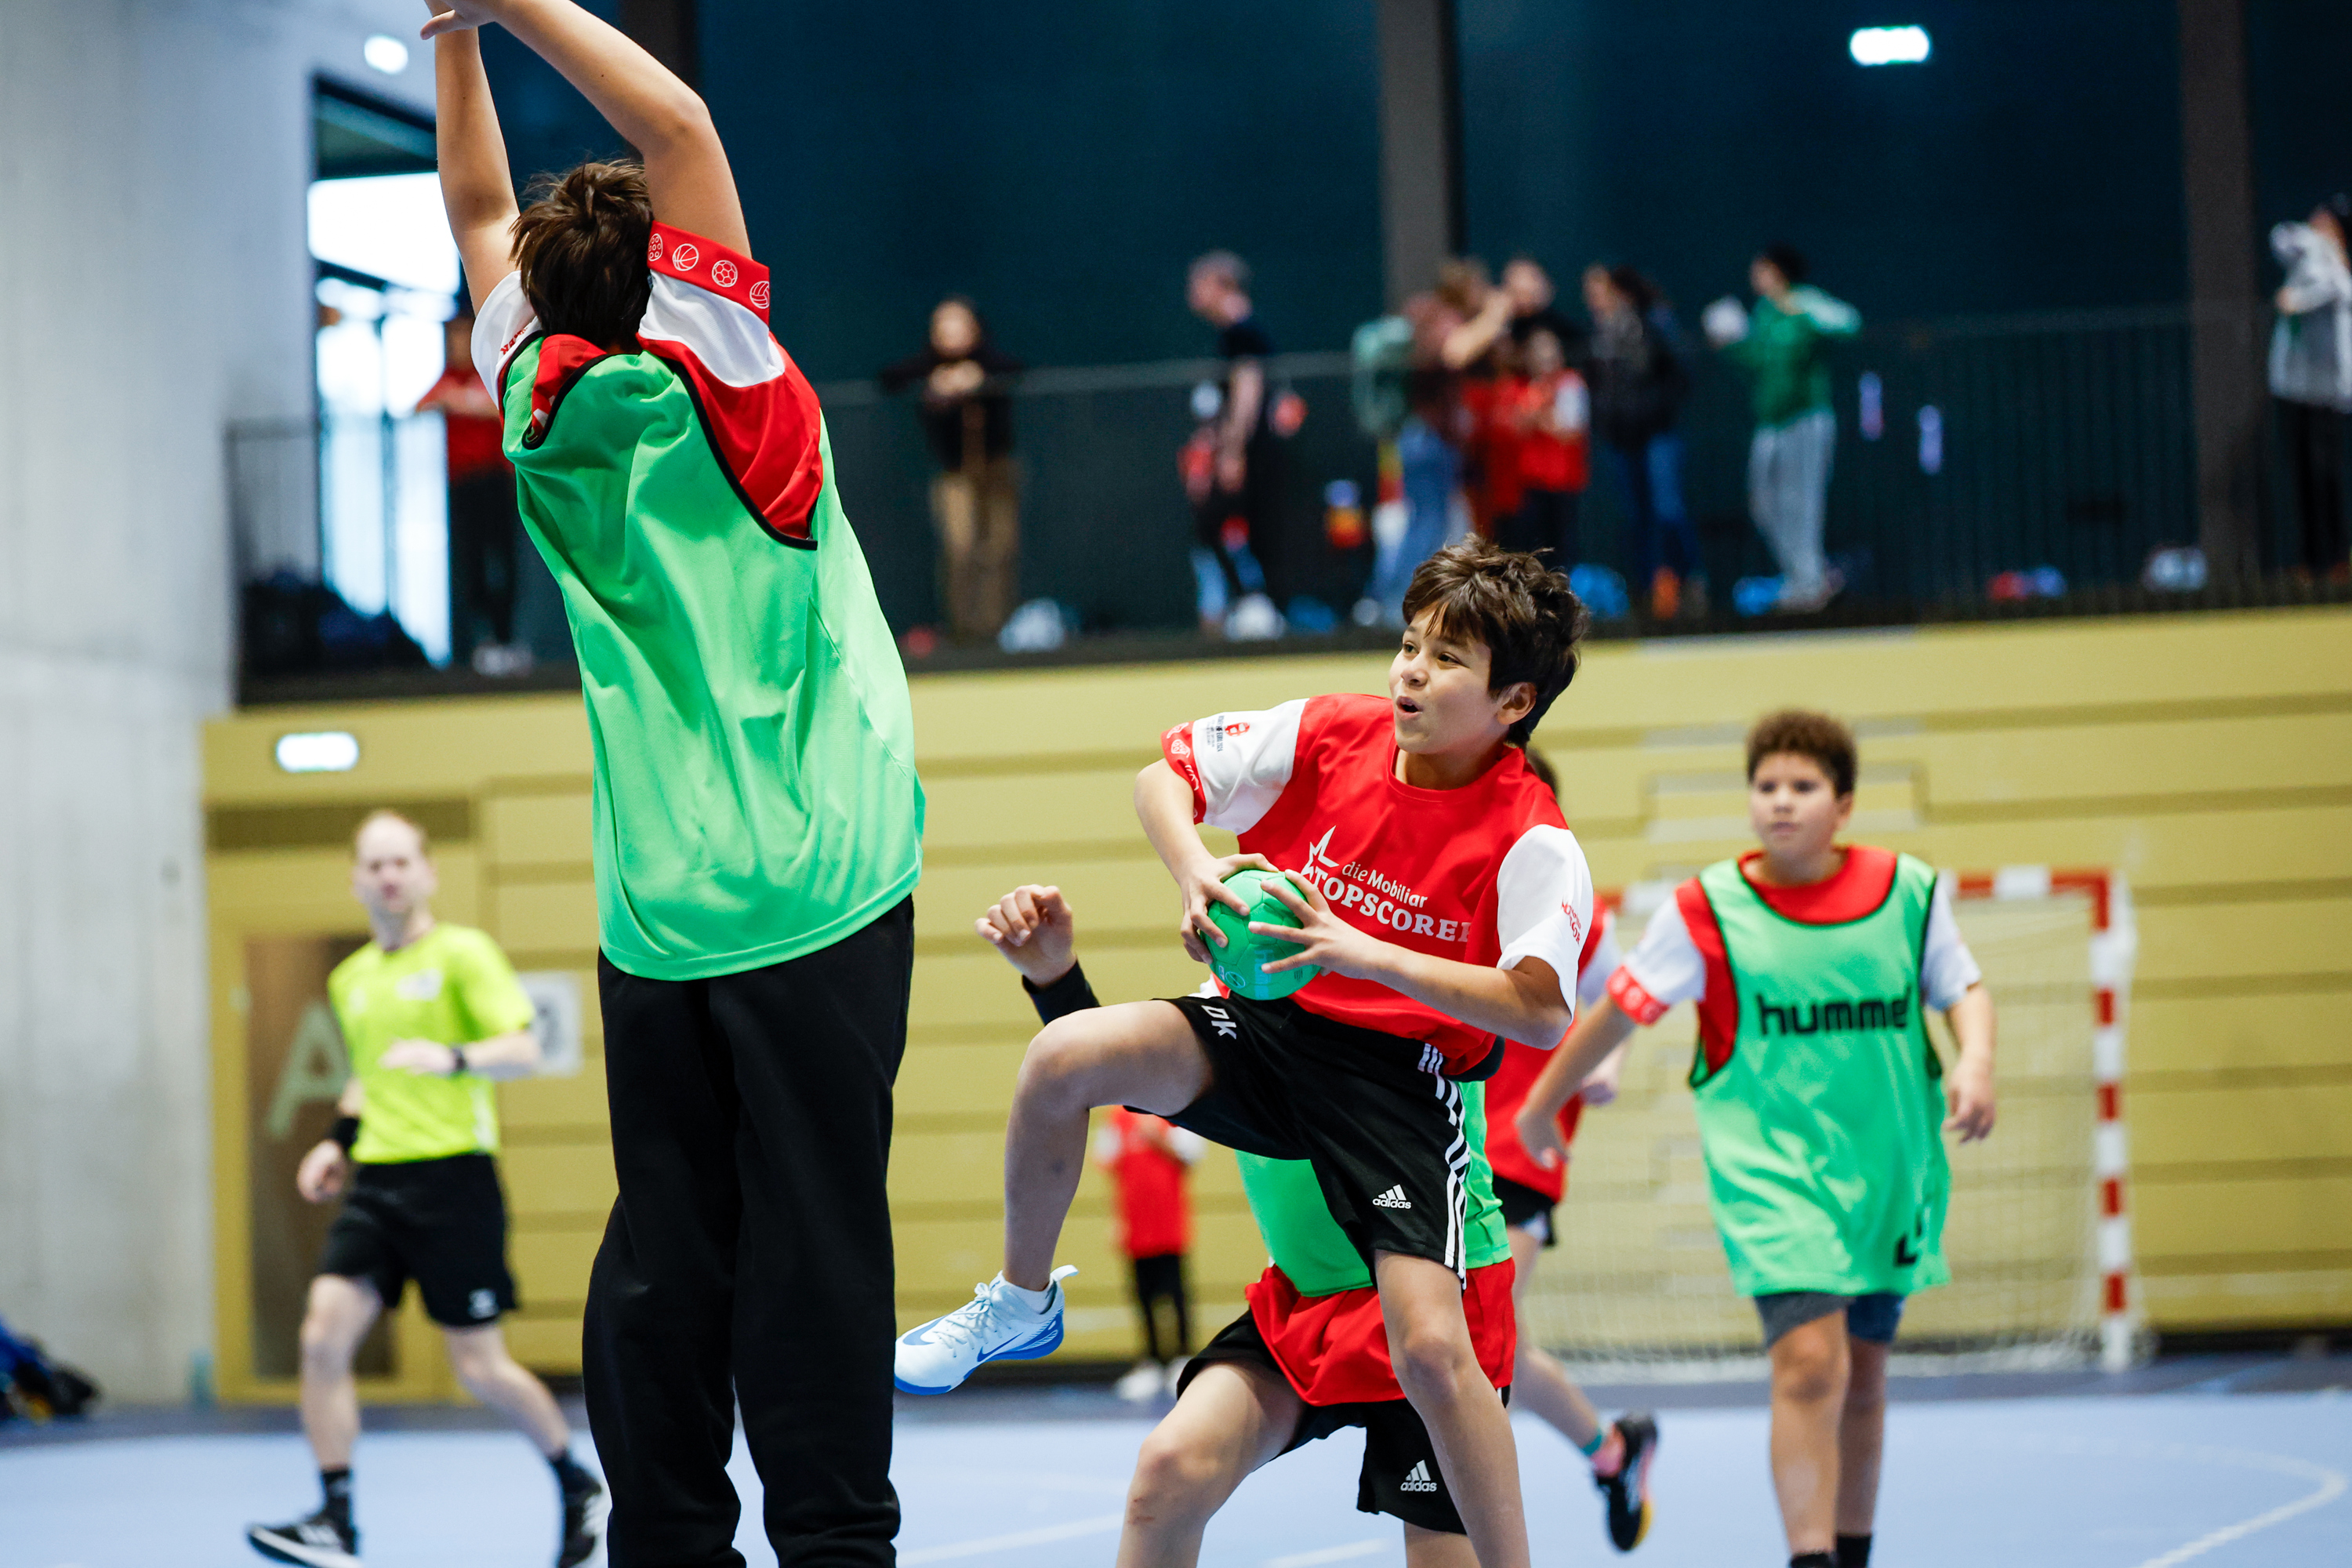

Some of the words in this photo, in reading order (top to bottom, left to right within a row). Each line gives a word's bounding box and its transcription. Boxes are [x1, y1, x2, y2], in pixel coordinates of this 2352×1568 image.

[1341, 861, 1368, 882] die
[1367, 869, 1428, 909] Mobiliar
[1373, 1198, 1411, 1209] adidas
